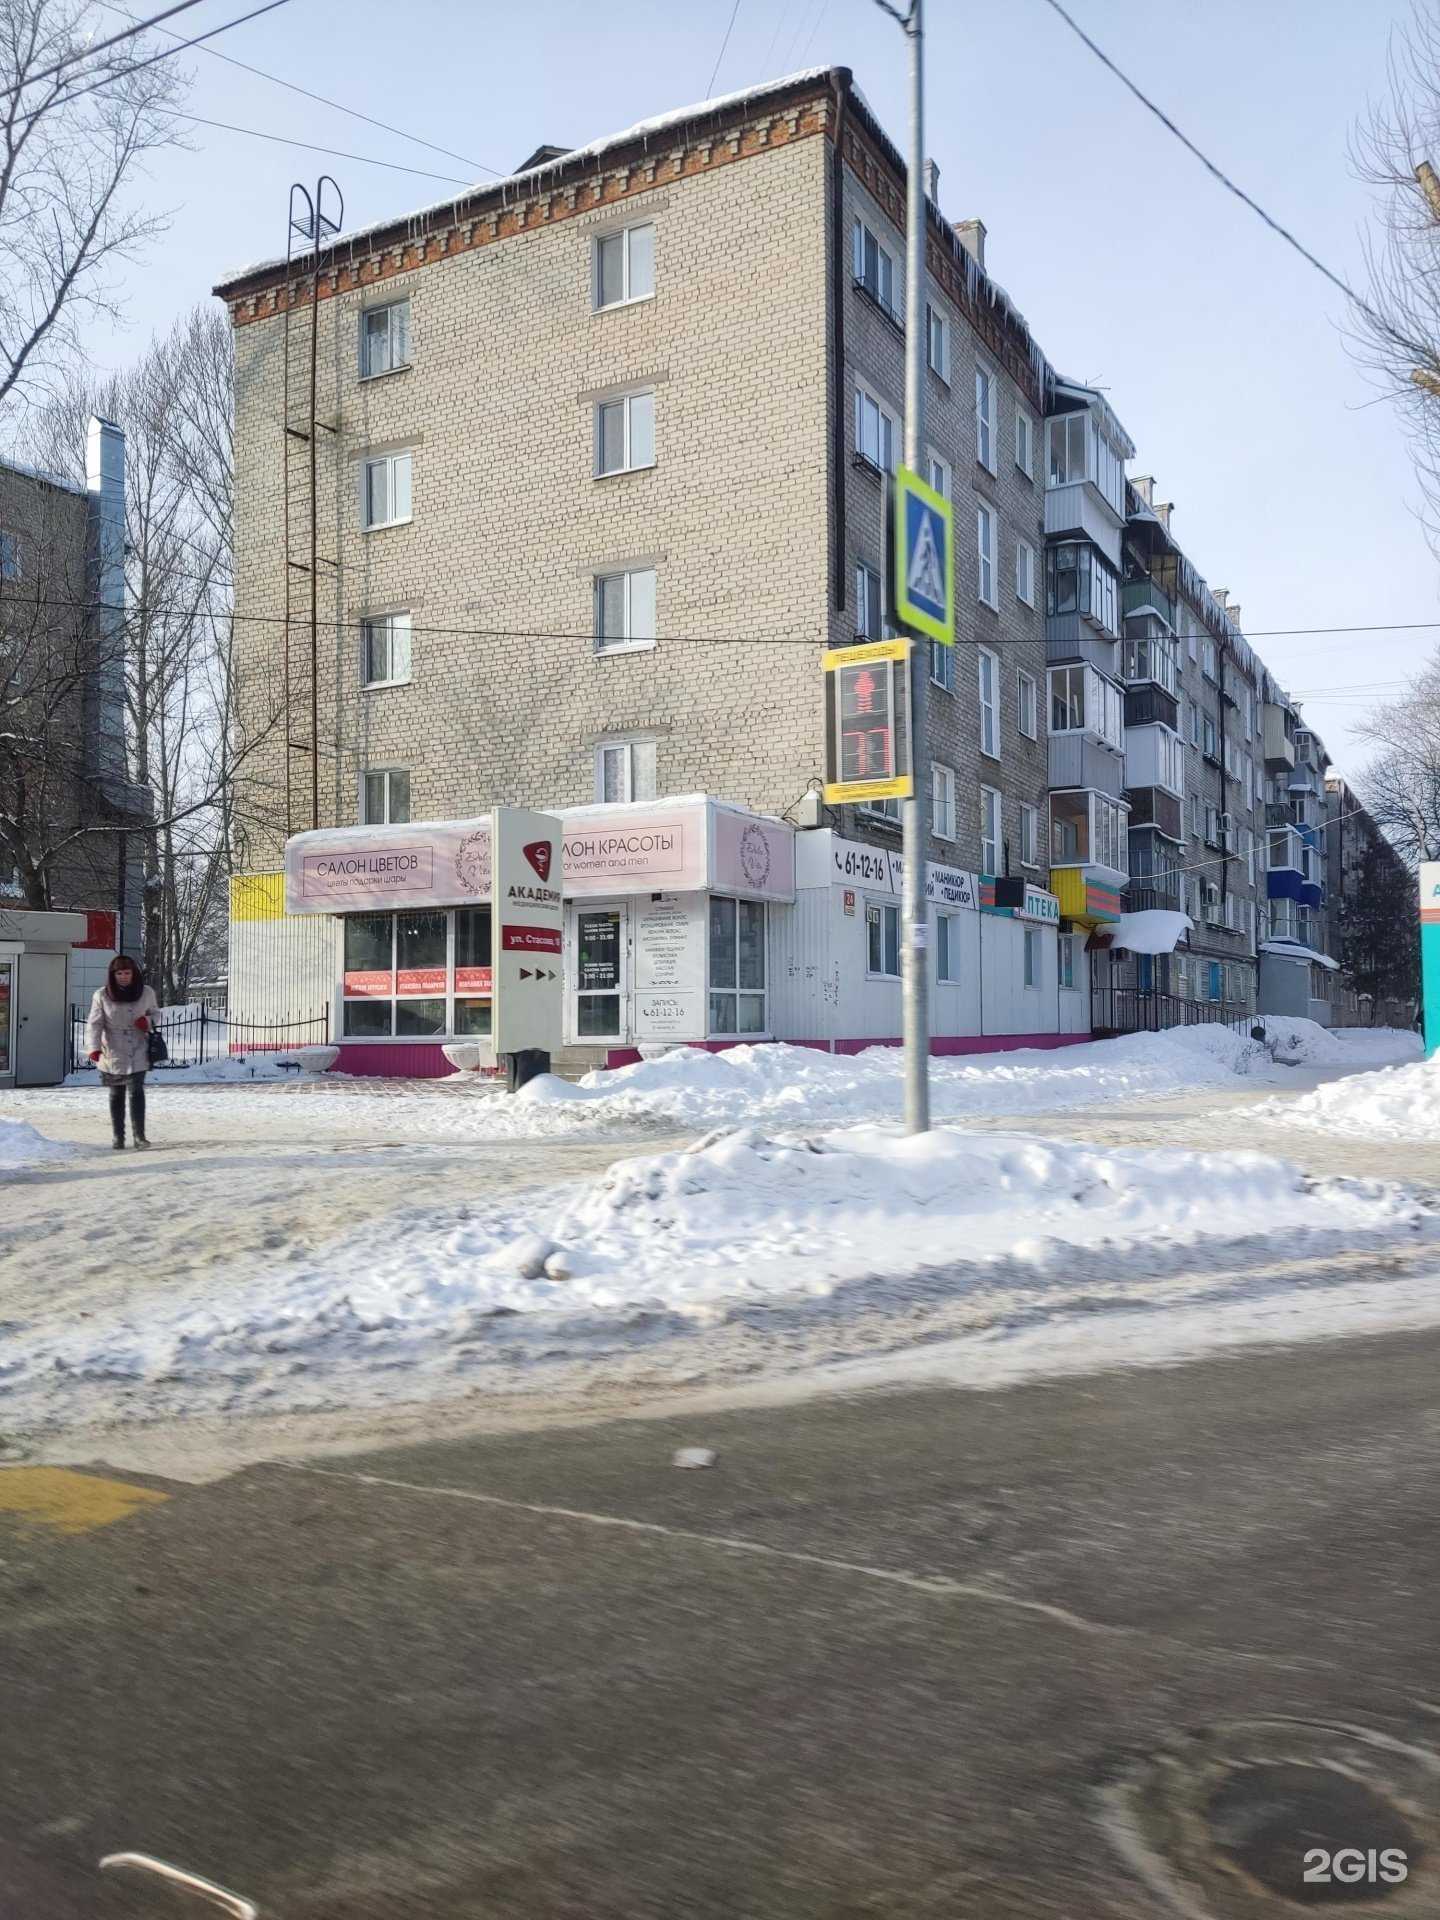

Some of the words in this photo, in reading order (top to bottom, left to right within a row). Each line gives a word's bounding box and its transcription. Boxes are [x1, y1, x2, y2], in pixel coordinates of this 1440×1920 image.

[562, 840, 595, 857] ЛОН
[599, 834, 674, 855] КРАСОТЫ
[316, 858, 366, 877] САЛОН
[369, 854, 418, 874] ЦВЕТОВ
[563, 862, 572, 871] or
[573, 859, 607, 870] women
[608, 857, 627, 868] and
[627, 856, 648, 866] men
[845, 850, 884, 881] 61-12-16
[935, 871, 965, 889] МАНИКЮР
[944, 888, 971, 903] ПЕДИКЮР
[1027, 895, 1060, 920] ПТЕКА
[650, 1008, 685, 1016] 61-12-16
